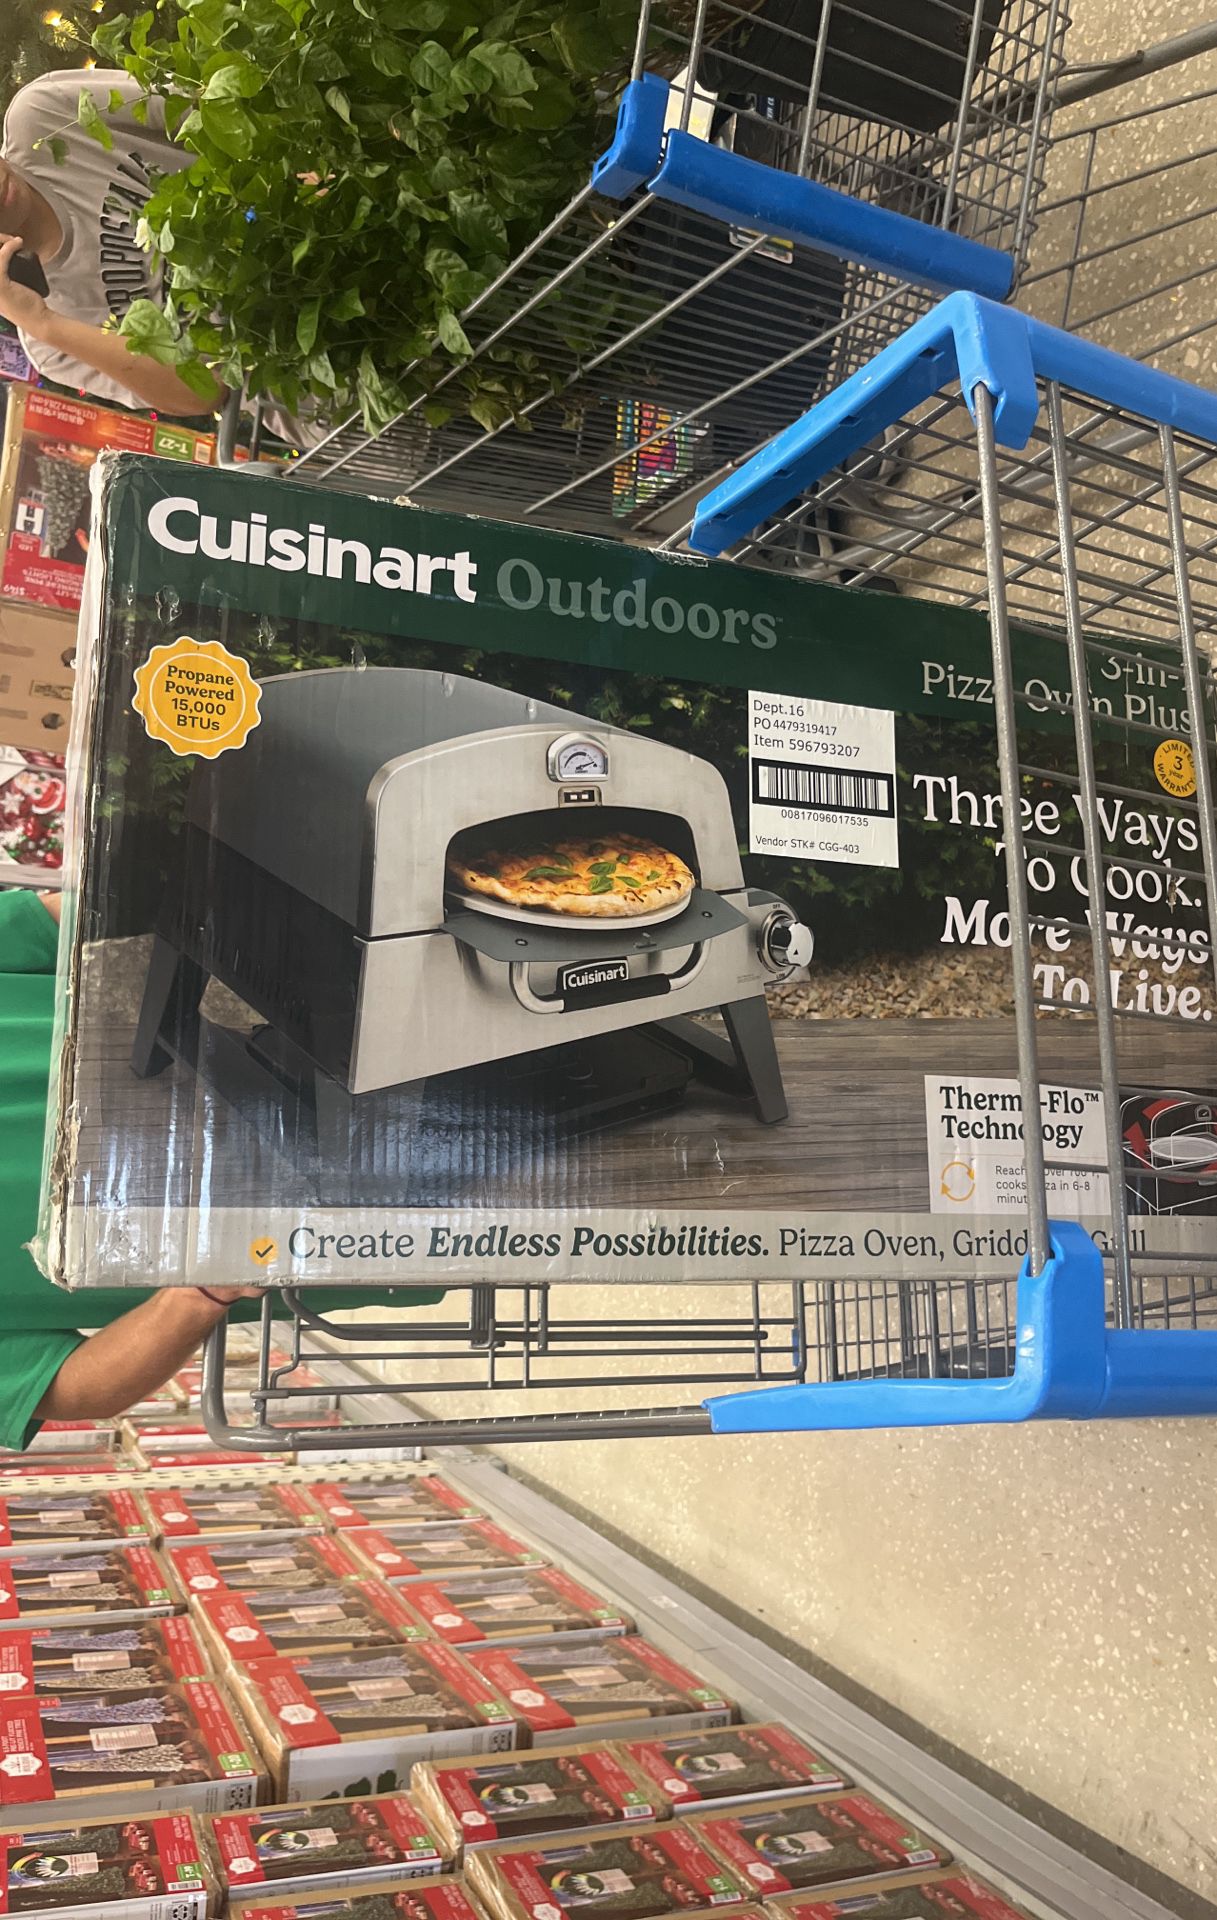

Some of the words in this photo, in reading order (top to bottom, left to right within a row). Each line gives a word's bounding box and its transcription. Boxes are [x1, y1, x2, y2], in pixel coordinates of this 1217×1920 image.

[158, 436, 189, 454] T-27
[147, 497, 478, 603] Cuisinart
[167, 665, 234, 685] Propane
[1101, 652, 1188, 691] 3-in-
[165, 680, 235, 701] Powered
[921, 661, 996, 704] Pizz
[1025, 679, 1112, 716] Ovn
[172, 698, 226, 716] 15,000
[753, 700, 804, 717] Dept.16
[177, 714, 220, 731] BTUs
[753, 717, 771, 730] PO
[773, 720, 837, 736] 4479319417
[754, 734, 784, 749] Item
[789, 738, 860, 758] 596793207
[1173, 755, 1184, 771] 3
[1157, 763, 1196, 793] WARRANTY
[781, 808, 869, 827] 00817096017535
[755, 835, 788, 847] Vendor
[790, 838, 815, 849] STK#
[819, 841, 860, 854] CGG-403
[567, 965, 626, 988] Cuisinart
[1033, 964, 1090, 1012] To
[1109, 969, 1212, 1021] Live.
[939, 1085, 1099, 1114] Therm-Flo™
[941, 1114, 1084, 1149] Technogy
[995, 1165, 1027, 1176] Reach
[996, 1181, 1027, 1190] cooks
[1060, 1181, 1069, 1190] in
[1073, 1181, 1090, 1191] 6-8
[997, 1193, 1028, 1204] minut
[287, 1226, 415, 1259] Create
[426, 1225, 562, 1258] Endless
[570, 1225, 769, 1257] Possibilities.
[779, 1228, 855, 1257] Pizza
[863, 1228, 945, 1261] Oven,
[953, 1228, 1028, 1257] Gridd
[1091, 1229, 1146, 1251] Gll
